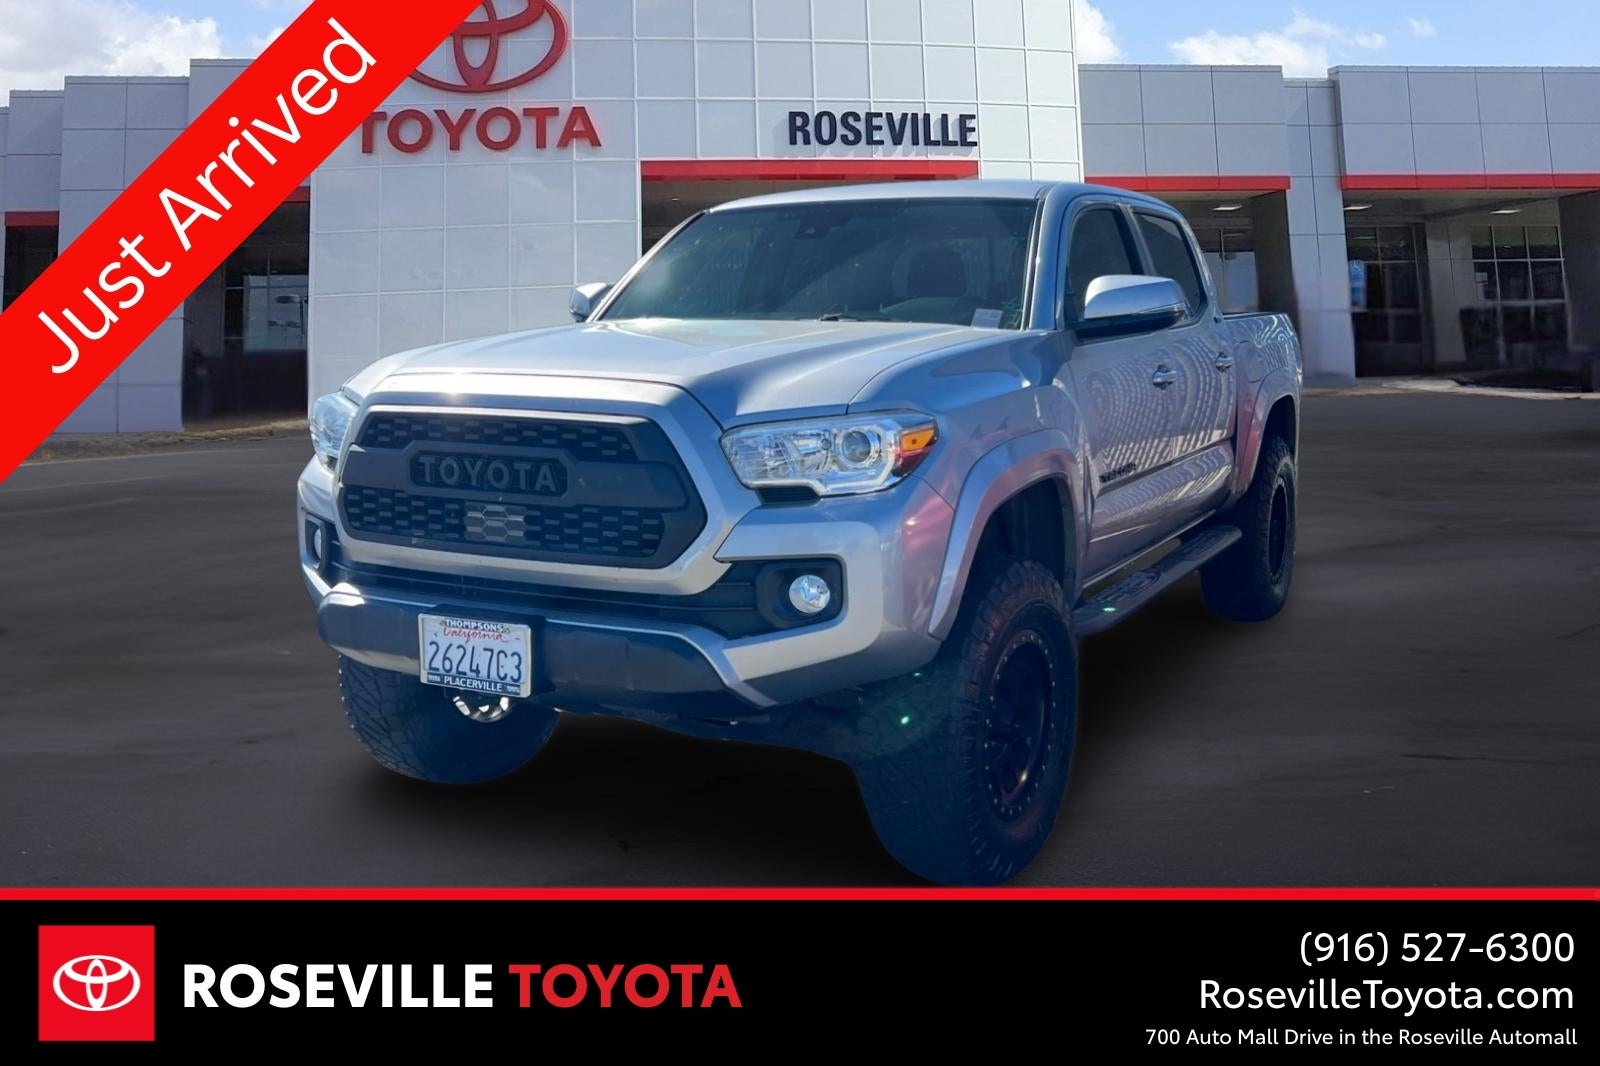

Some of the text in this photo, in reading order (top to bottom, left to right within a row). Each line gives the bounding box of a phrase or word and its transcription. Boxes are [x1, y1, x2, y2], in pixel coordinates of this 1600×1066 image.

[361, 105, 602, 154] TOYOTA
[788, 110, 978, 147] ROSEVILLE
[417, 455, 558, 492] TOYOTA
[442, 625, 509, 643] California
[445, 619, 504, 632] THOMPSONS
[428, 641, 522, 684] 26247C3
[444, 676, 503, 692] PLACERVILLE
